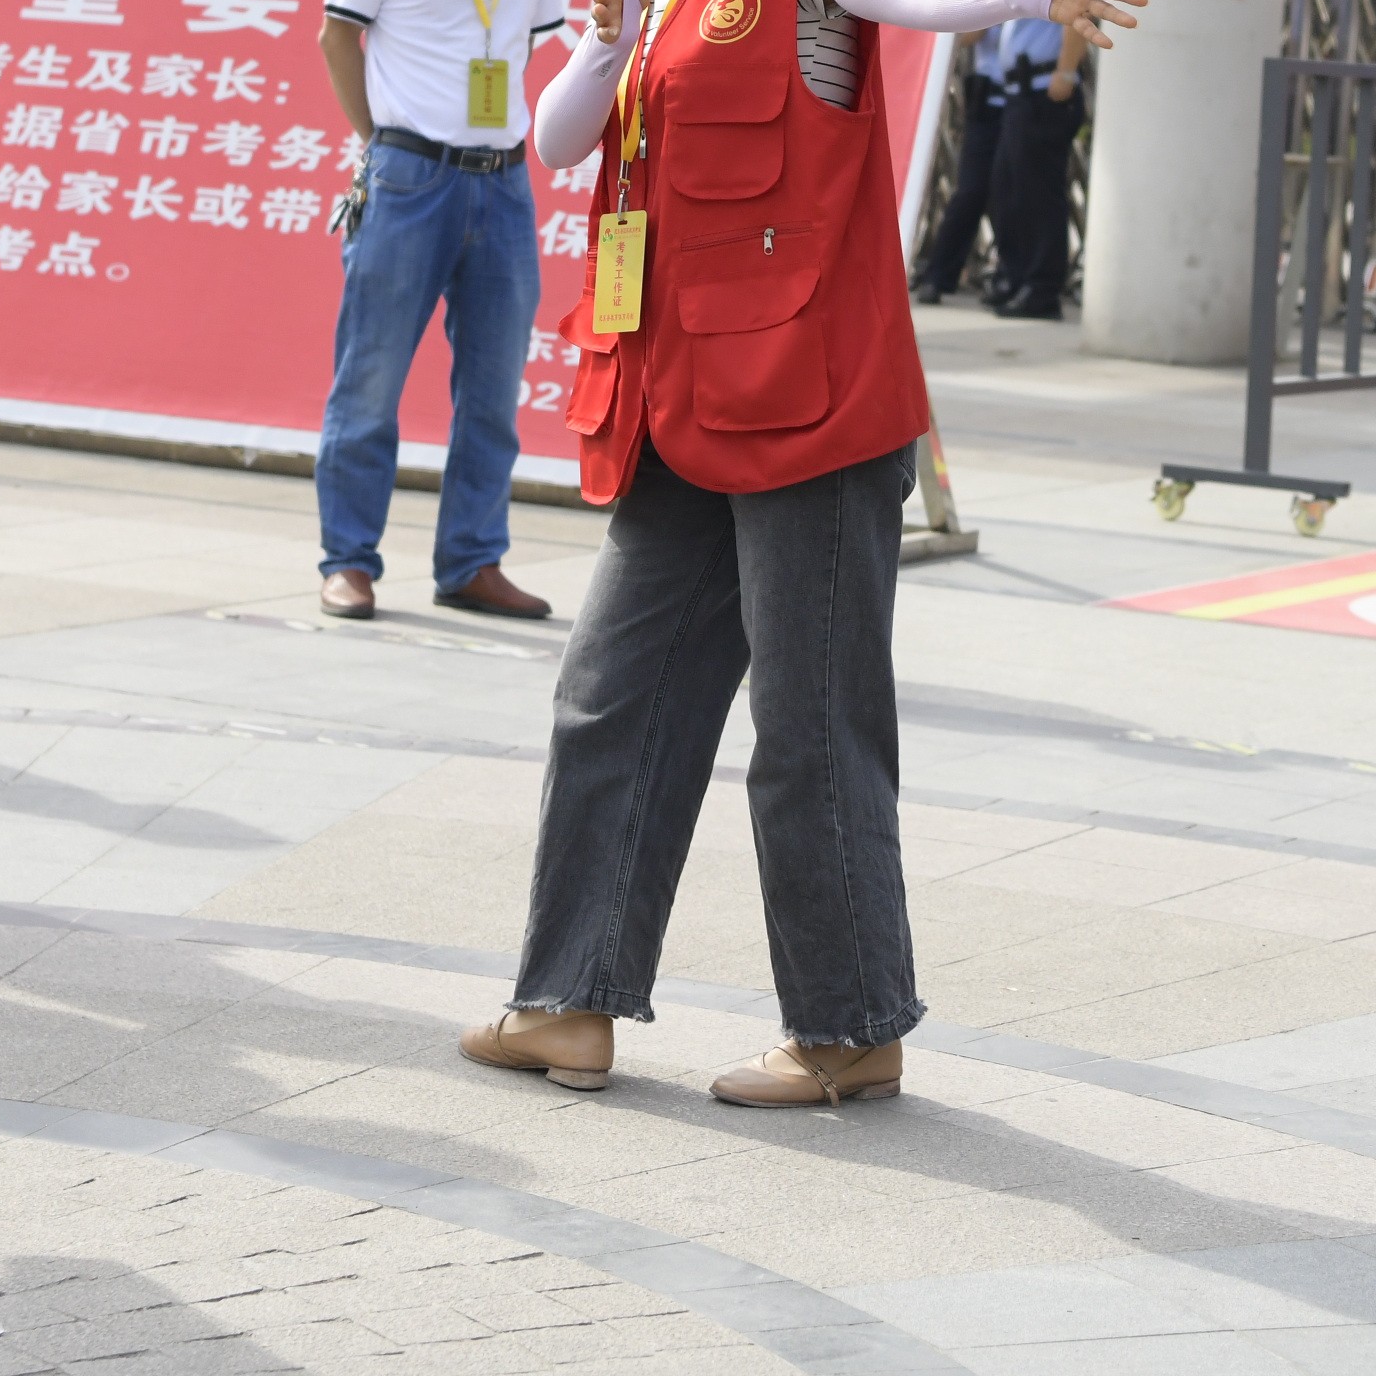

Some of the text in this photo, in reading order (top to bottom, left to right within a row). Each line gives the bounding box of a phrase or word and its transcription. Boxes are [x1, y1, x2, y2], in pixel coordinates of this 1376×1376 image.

[613, 242, 625, 306] 考务工作证
